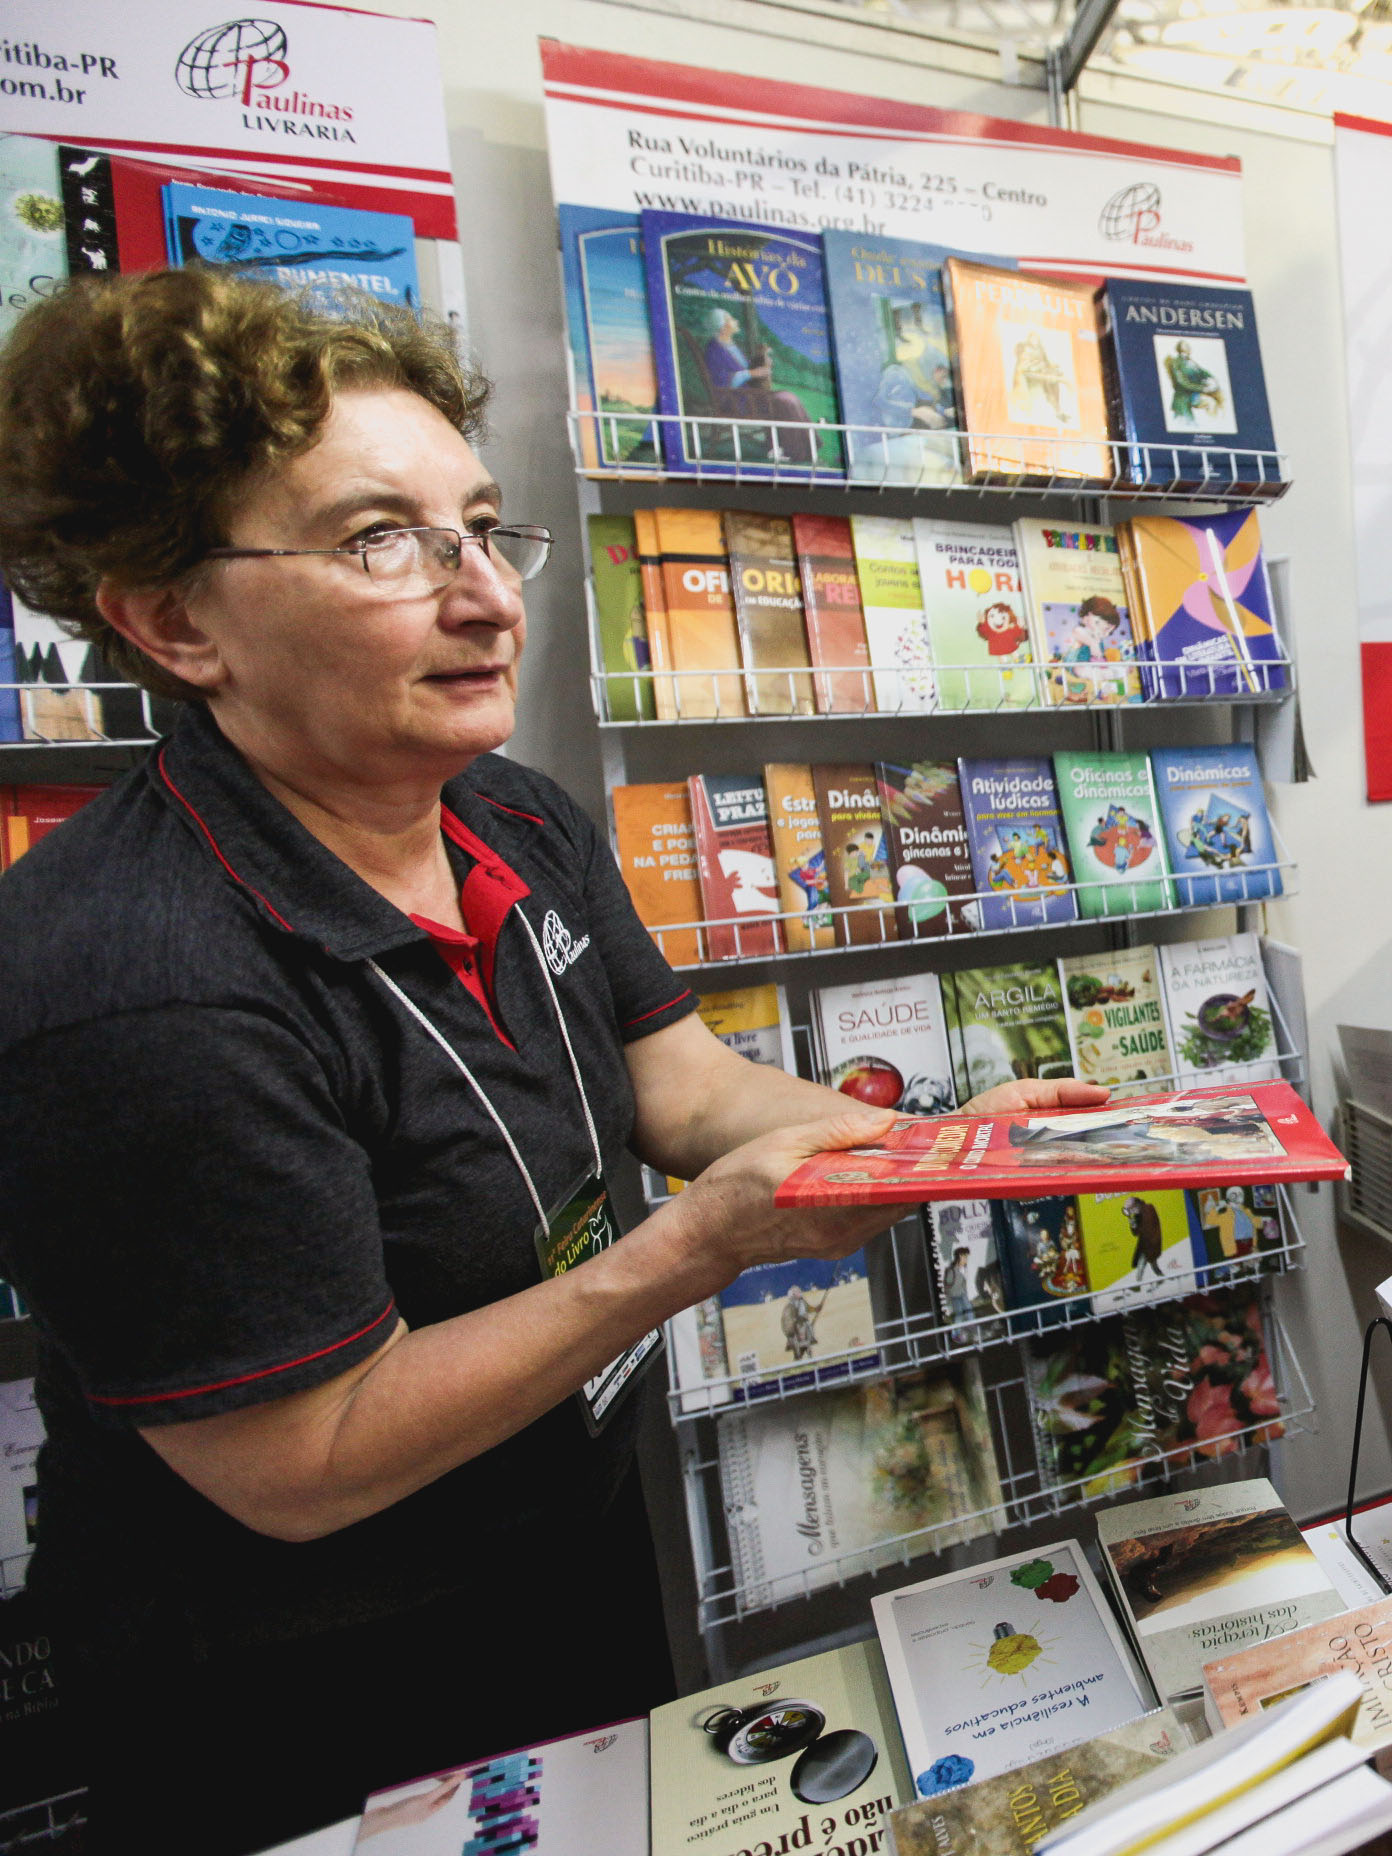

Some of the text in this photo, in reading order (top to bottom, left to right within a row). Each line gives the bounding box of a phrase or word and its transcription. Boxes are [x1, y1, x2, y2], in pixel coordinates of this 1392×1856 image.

[0, 36, 119, 81] itiba-PR
[223, 53, 355, 123] Paulinas
[242, 113, 358, 145] LIVRARIA
[627, 129, 1048, 209] Rua Voluntários da Pátria, 225 Centro
[630, 157, 876, 209] Curitiba-PR Tel. (41)
[1126, 209, 1194, 253] Paulinas
[975, 281, 1085, 318] PERRAULT
[1125, 304, 1246, 331] ANDERSEN
[949, 554, 986, 568] PARA
[1071, 767, 1133, 784] Oficinas
[1166, 764, 1252, 783] Dinâmicas
[990, 791, 1051, 810] lúdicas
[1073, 782, 1151, 800] dinâmicas
[902, 846, 951, 864] gincanas
[1170, 955, 1258, 978] A FARMÁCIA
[1171, 969, 1259, 992] DA NATUREZA
[975, 983, 1057, 1010] ARGILA
[838, 1000, 931, 1033] SAÚDE
[975, 1010, 992, 1022] UM
[993, 1006, 1021, 1020] SANTO
[1022, 1001, 1059, 1015] REMÉDIO
[1104, 1000, 1162, 1029] VIGILANTES
[848, 1029, 899, 1044] QUALIDADE
[900, 1027, 913, 1037] DE
[913, 1023, 932, 1034] VIDA
[1119, 1027, 1166, 1057] SAÚDE
[971, 1122, 995, 1150] IMORTAL
[567, 1230, 591, 1259] Livro
[1156, 1326, 1195, 1401] Vida
[794, 1432, 824, 1556] Mensagens
[1267, 1603, 1298, 1619] das
[1200, 1627, 1261, 1651] terapia
[943, 1672, 1105, 1737] ambientes educativos
[998, 1699, 1073, 1731] resiliência
[971, 1726, 997, 1741] em
[716, 1775, 777, 1803] dos líderes
[752, 1787, 778, 1803] para
[1048, 1767, 1081, 1808] DIA
[689, 1812, 709, 1829] dia
[725, 1799, 740, 1815] dia
[843, 1795, 894, 1830] não
[686, 1802, 781, 1844] Um guia prático
[820, 1815, 837, 1846] é
